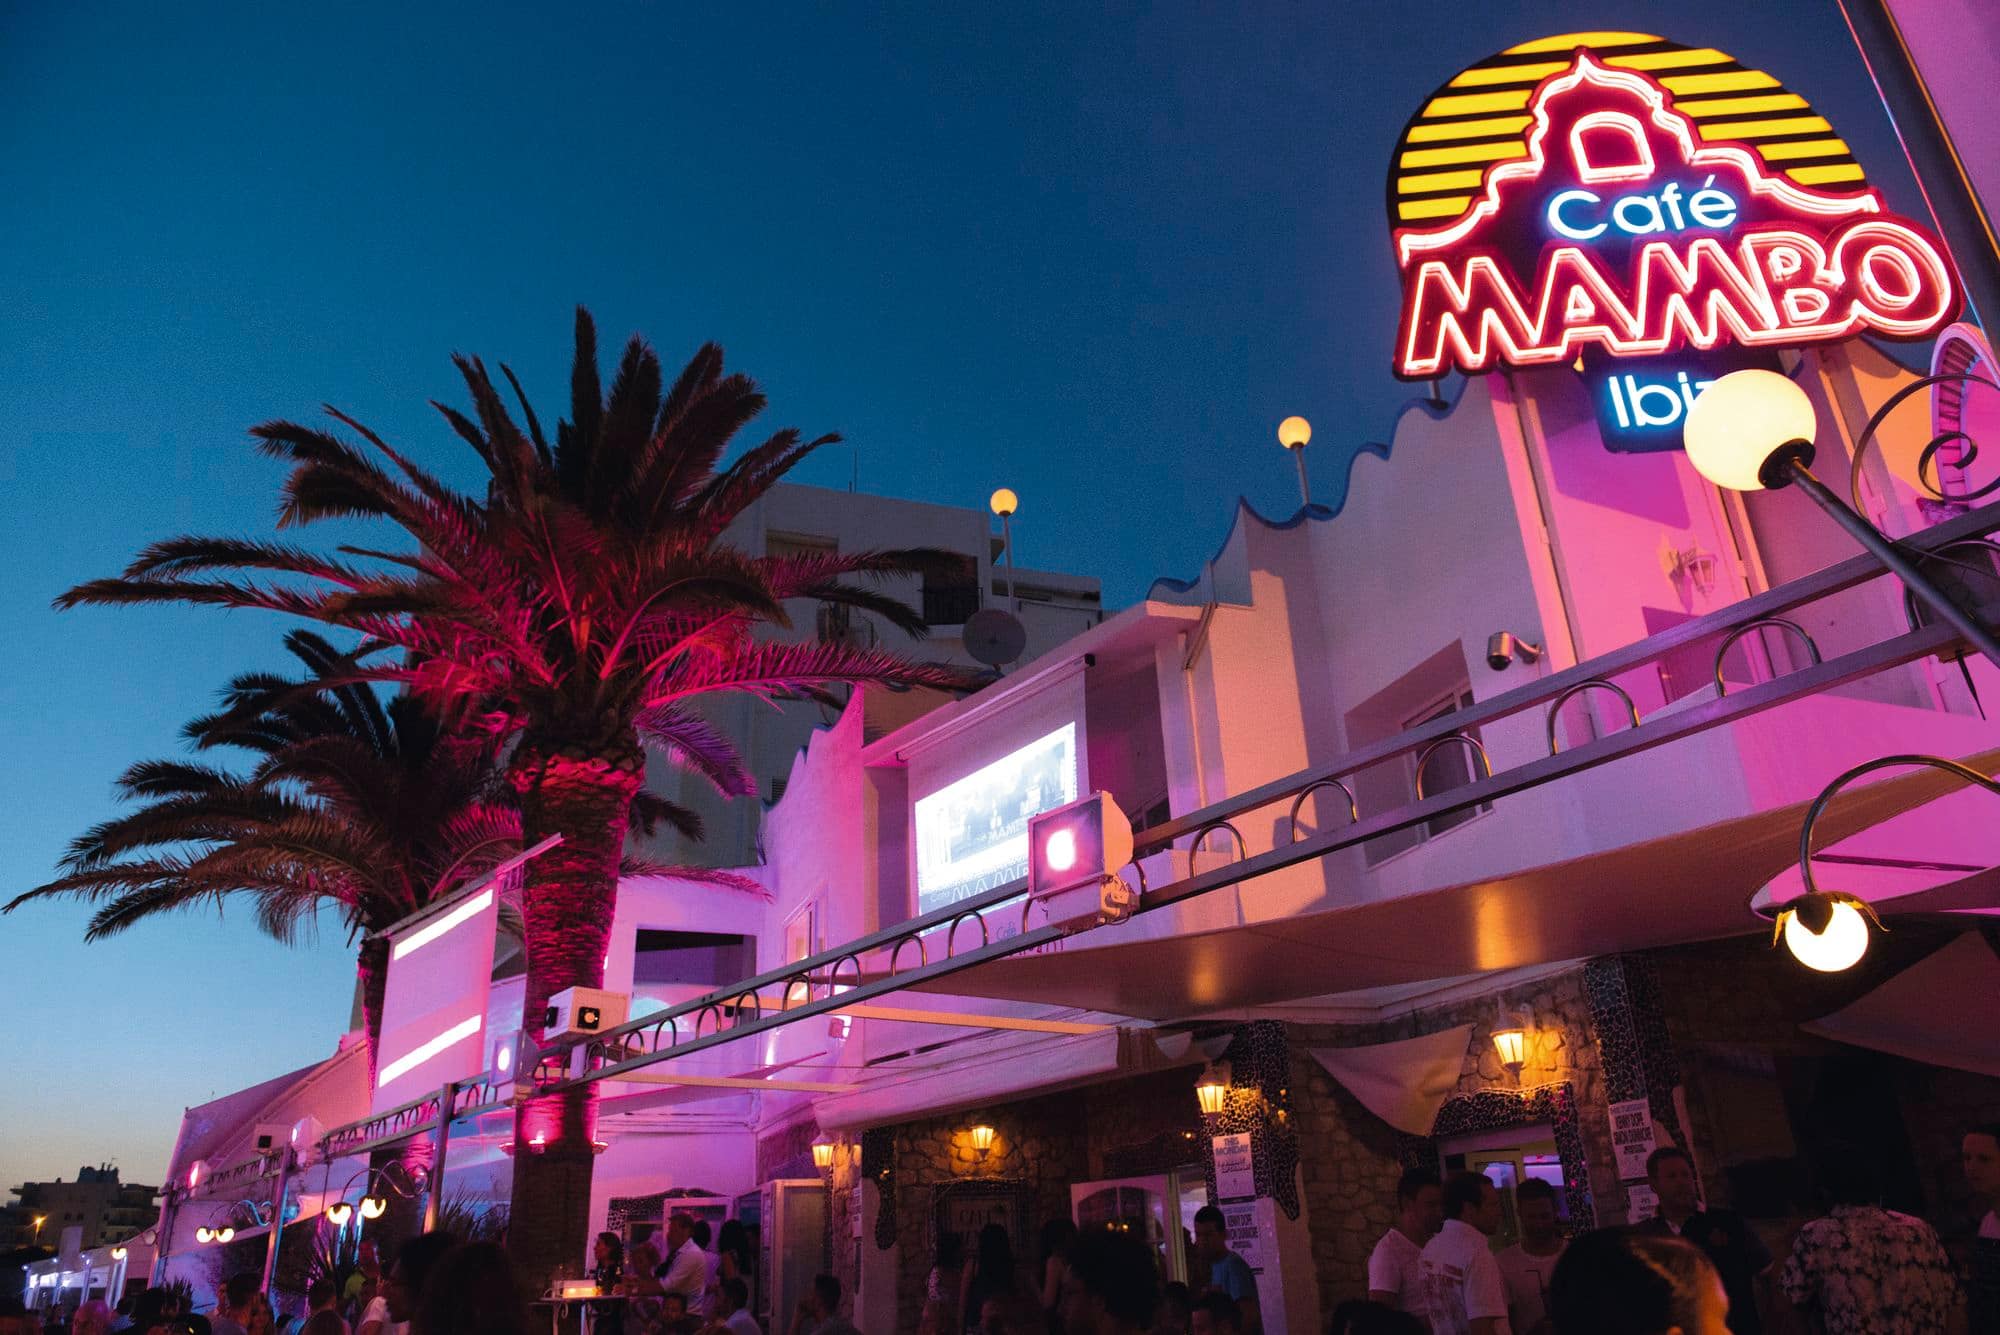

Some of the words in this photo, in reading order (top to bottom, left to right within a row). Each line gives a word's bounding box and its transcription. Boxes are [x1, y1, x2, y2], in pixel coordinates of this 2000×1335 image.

[1548, 175, 1737, 240] Café
[1402, 221, 1953, 375] MAMBO
[1216, 1144, 1249, 1156] MONDAY
